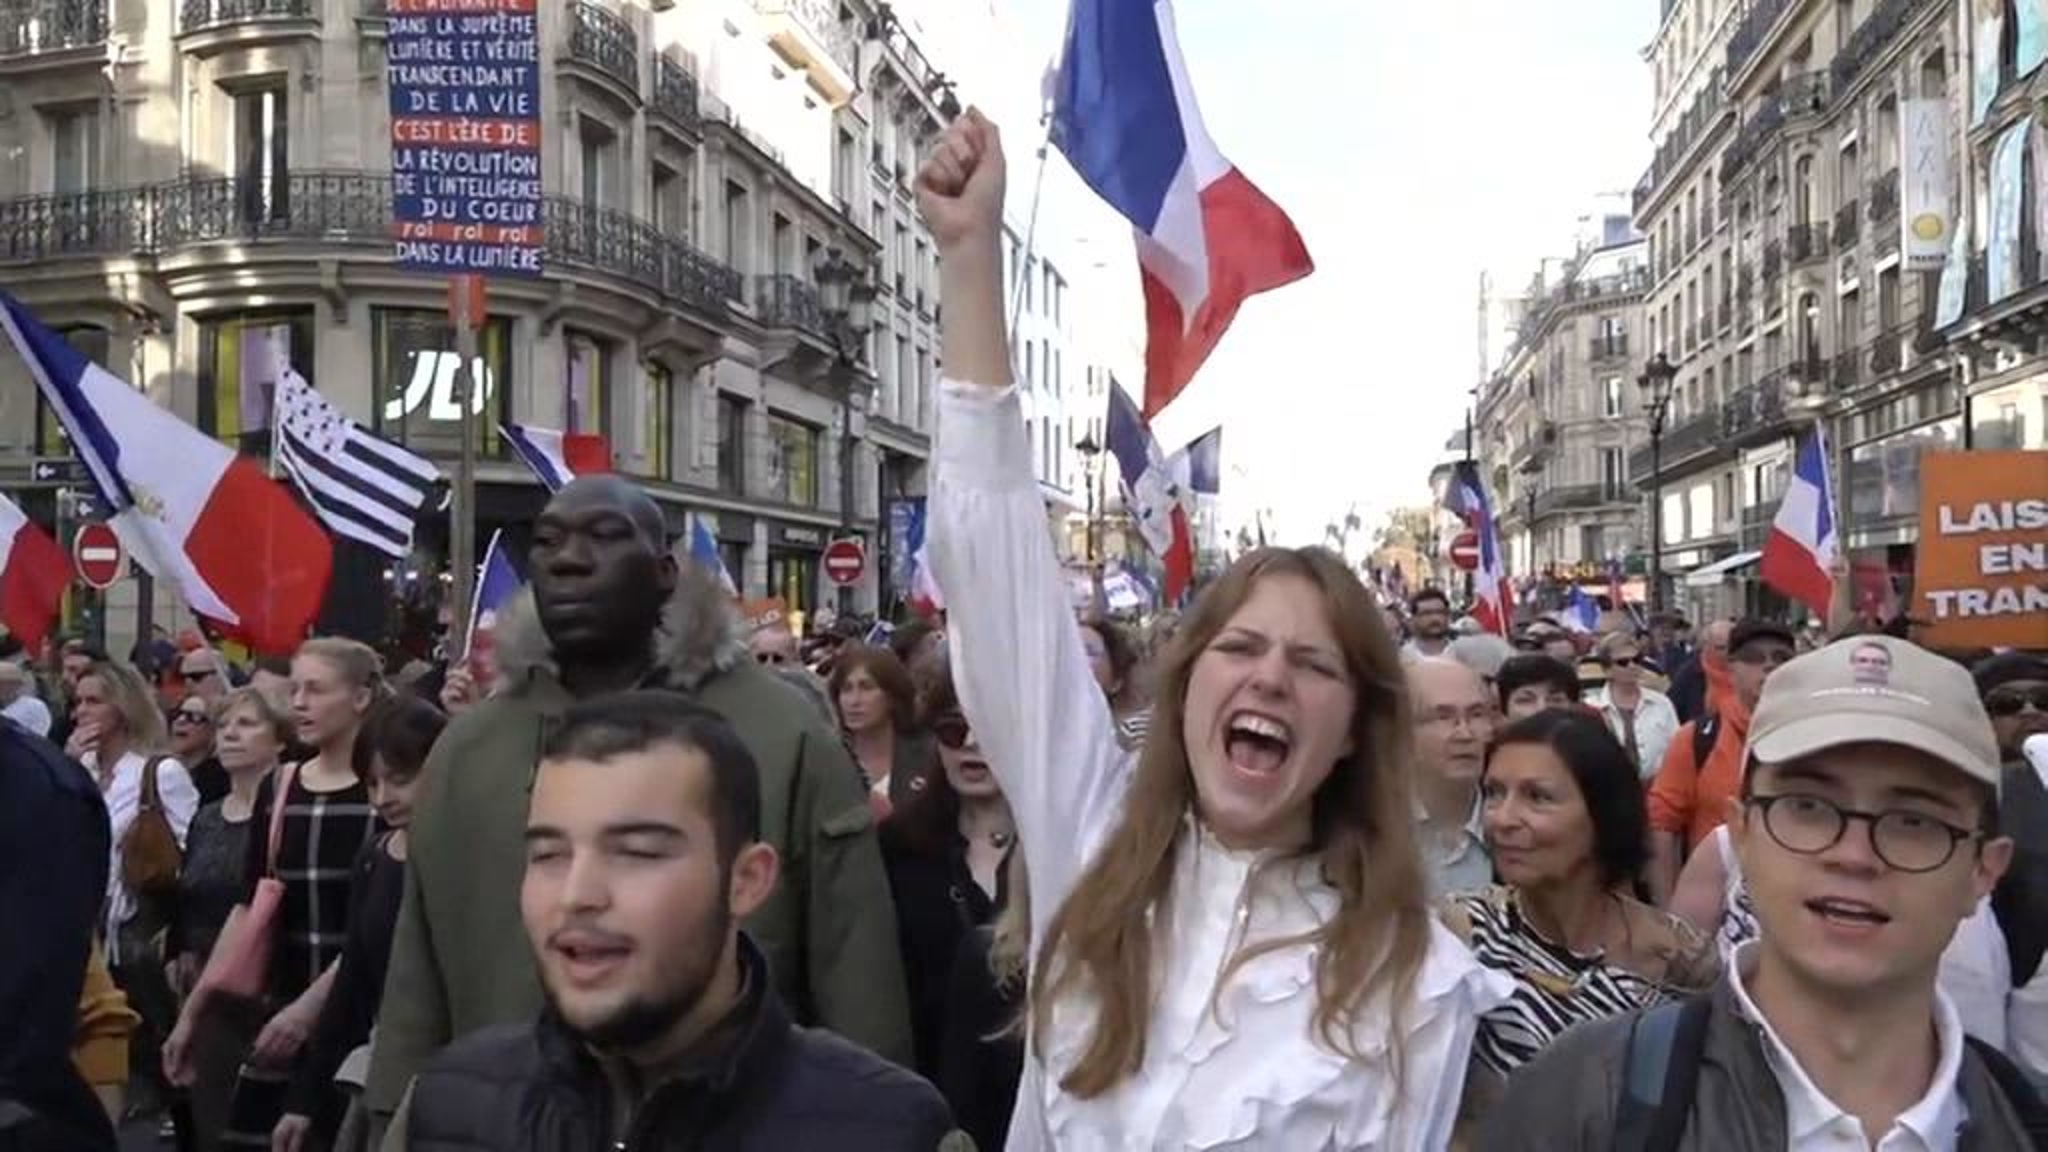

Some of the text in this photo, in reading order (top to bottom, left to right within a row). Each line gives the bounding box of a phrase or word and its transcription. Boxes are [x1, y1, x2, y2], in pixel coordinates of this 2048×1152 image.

[388, 16, 428, 34] DANS
[436, 17, 455, 34] LA
[460, 40, 481, 60] ET
[388, 65, 528, 87] TRANSCENDANT
[409, 90, 441, 112] DE
[452, 93, 479, 113] LA
[501, 124, 529, 145] DE
[393, 149, 415, 170] LA
[395, 173, 416, 195] DE
[422, 198, 536, 222] DU COEUR
[395, 241, 441, 263] DANS
[444, 245, 465, 265] LA
[385, 350, 493, 421] JD
[1980, 543, 2045, 575] EN
